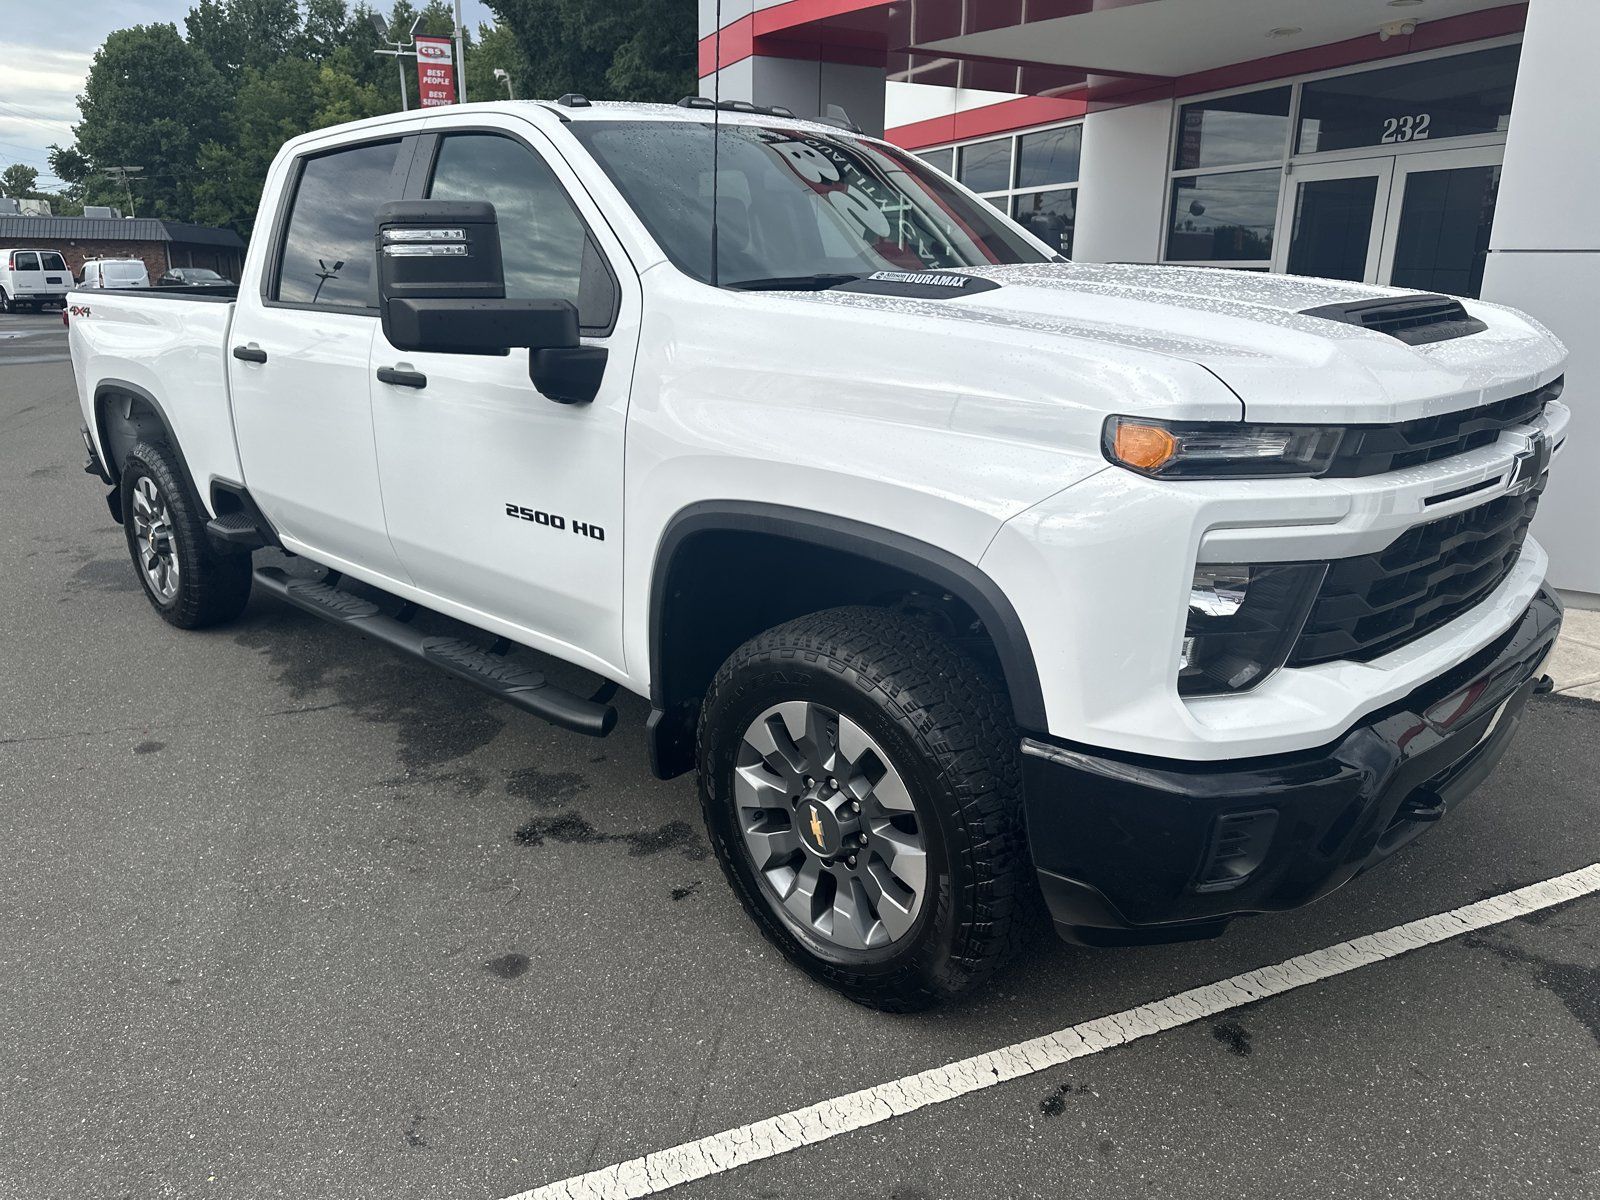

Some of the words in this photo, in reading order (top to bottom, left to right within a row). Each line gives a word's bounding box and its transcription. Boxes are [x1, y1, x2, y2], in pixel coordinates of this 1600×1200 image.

[421, 47, 441, 55] CBS
[427, 69, 445, 77] BEST
[423, 77, 449, 85] PEOPLE
[1381, 113, 1431, 143] 232
[906, 272, 968, 288] DURAMAX
[505, 502, 566, 530] 2500
[572, 519, 605, 541] HD
